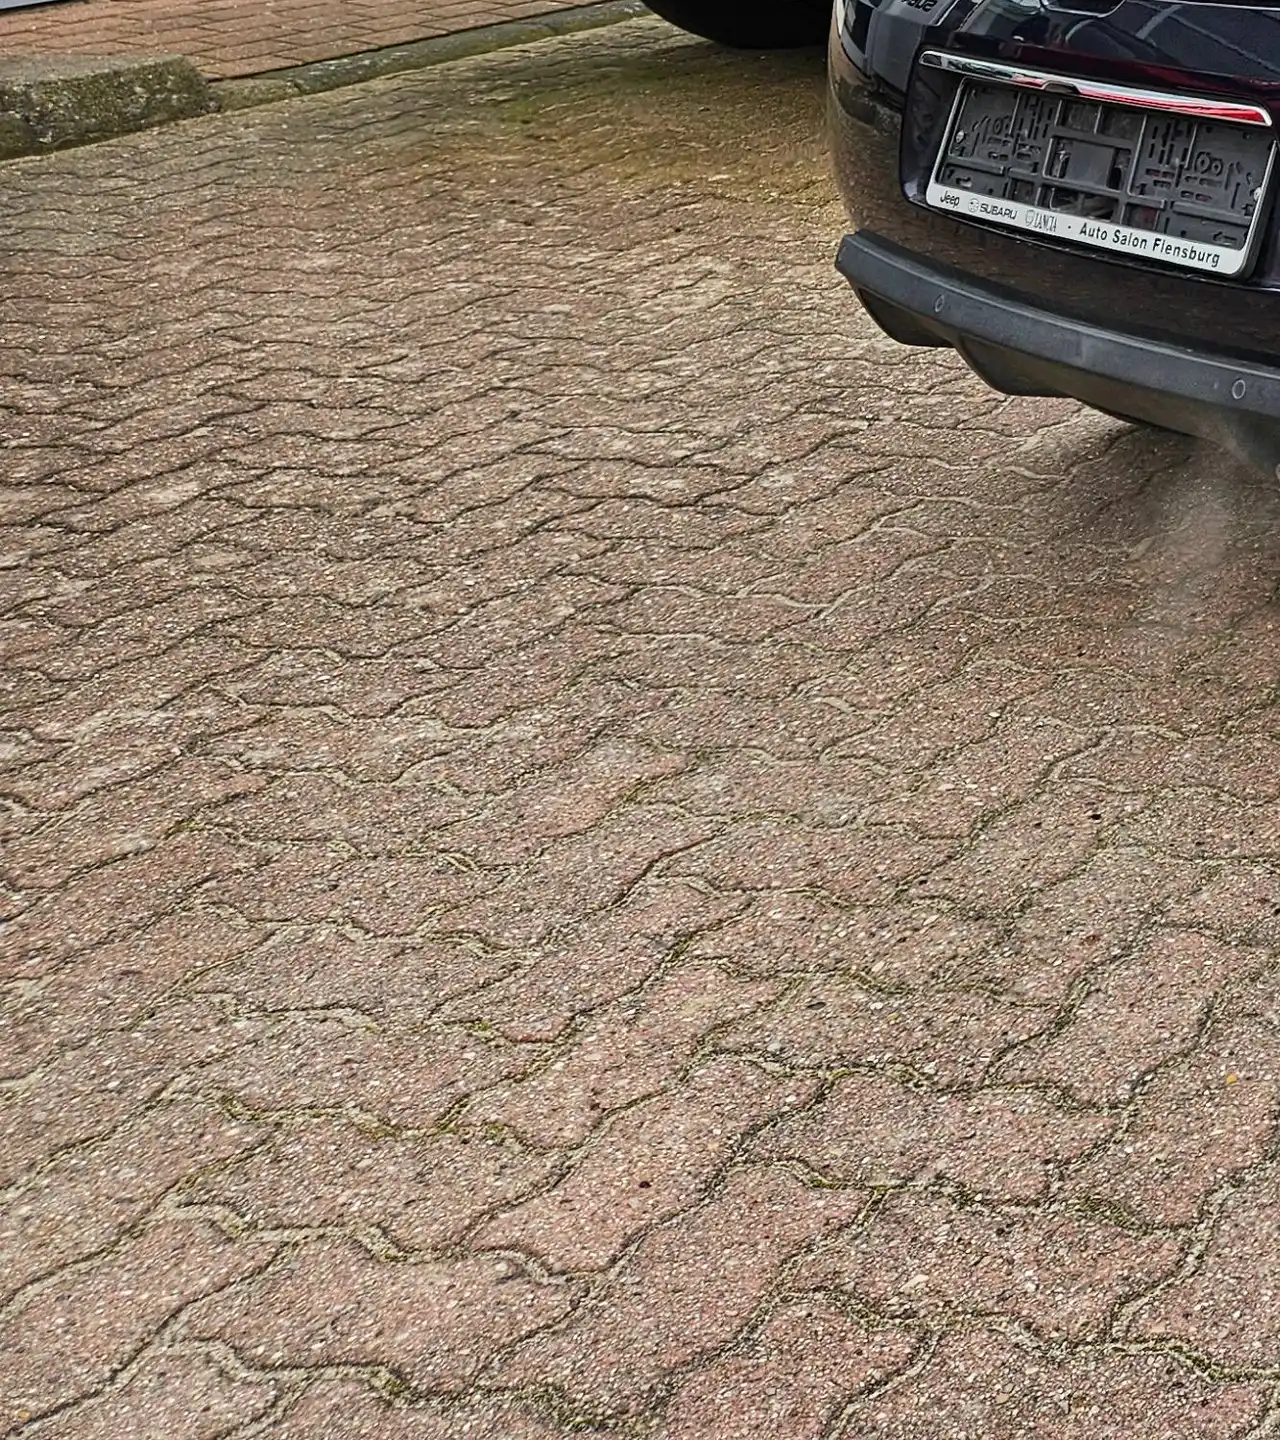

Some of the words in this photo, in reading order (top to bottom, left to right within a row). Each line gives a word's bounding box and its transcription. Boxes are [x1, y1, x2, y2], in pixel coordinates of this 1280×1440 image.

[939, 190, 960, 208] Jeep
[979, 203, 1017, 220] SUBARU
[1079, 222, 1108, 242] Auto
[1113, 230, 1148, 250] Salon
[1152, 238, 1221, 268] Flensburg
